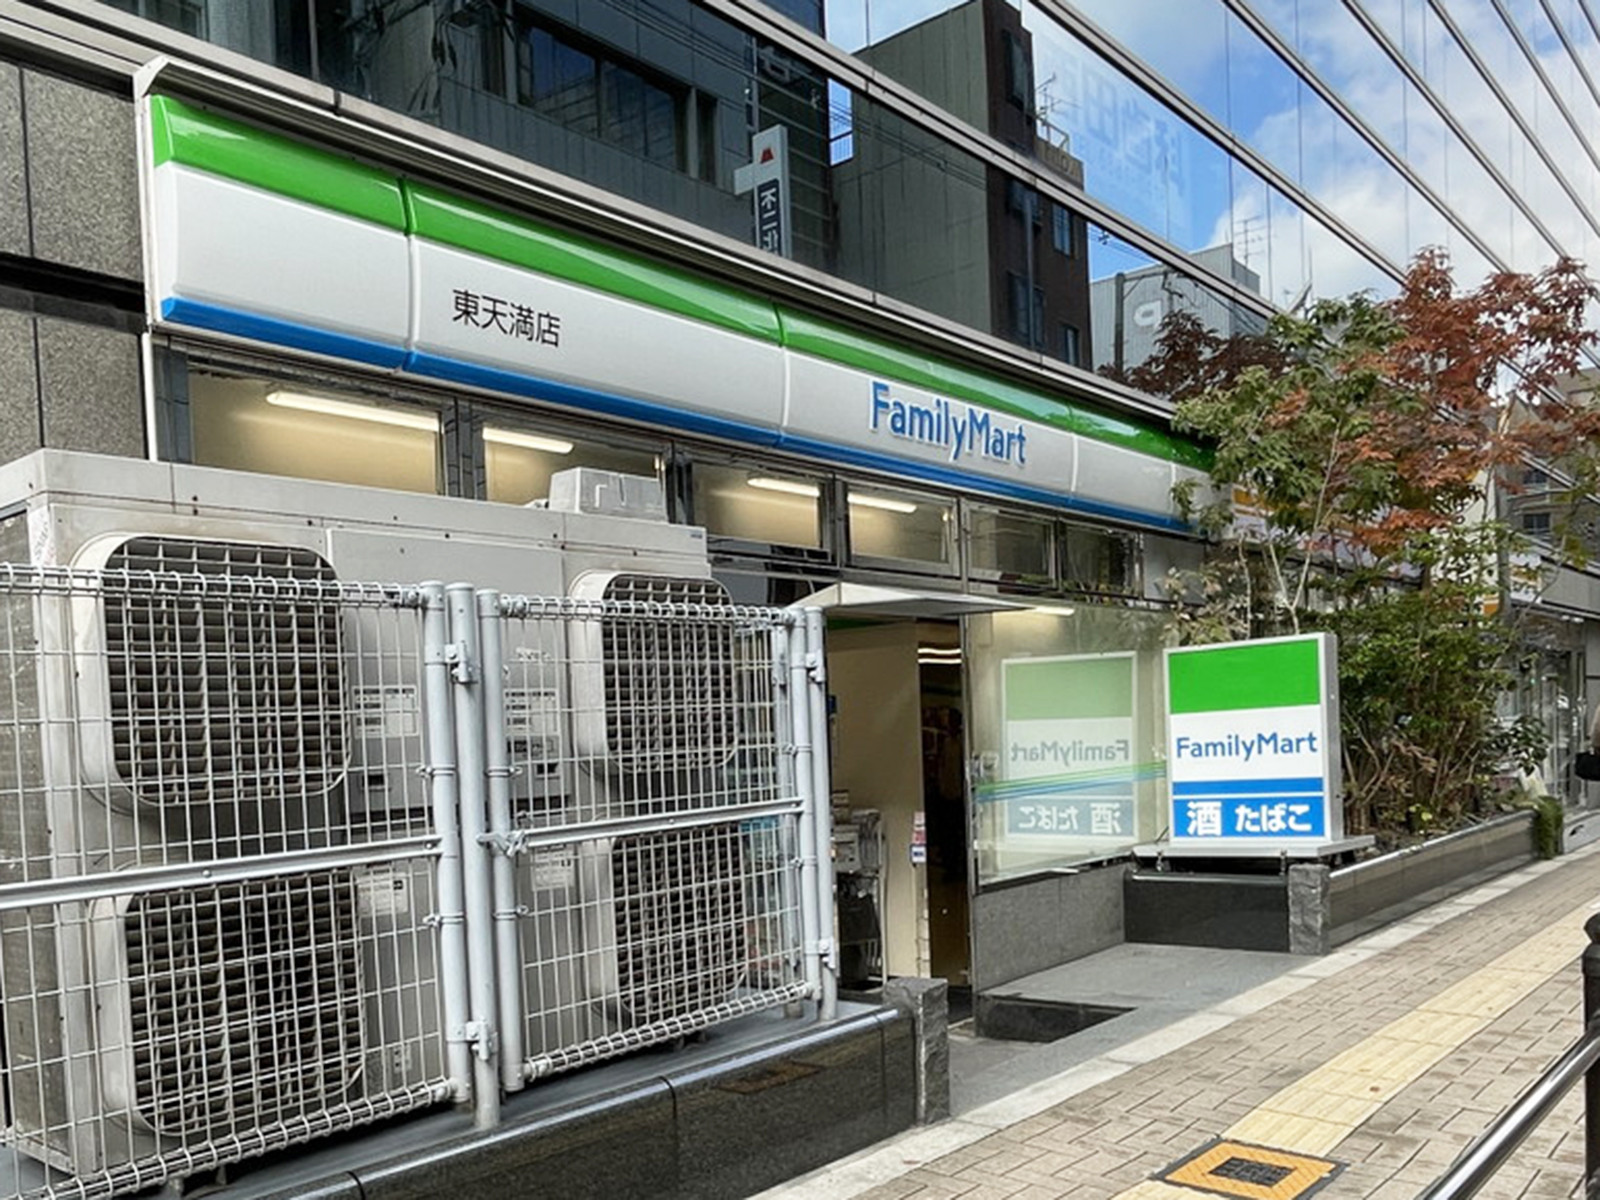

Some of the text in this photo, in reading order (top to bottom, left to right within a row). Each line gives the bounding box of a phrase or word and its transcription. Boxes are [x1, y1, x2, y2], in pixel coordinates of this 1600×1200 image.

[452, 288, 561, 348] 東天満店
[869, 381, 1026, 467] FamilyMart
[1176, 732, 1318, 762] FamilyMart
[1187, 801, 1312, 836] 酒 たばこ
